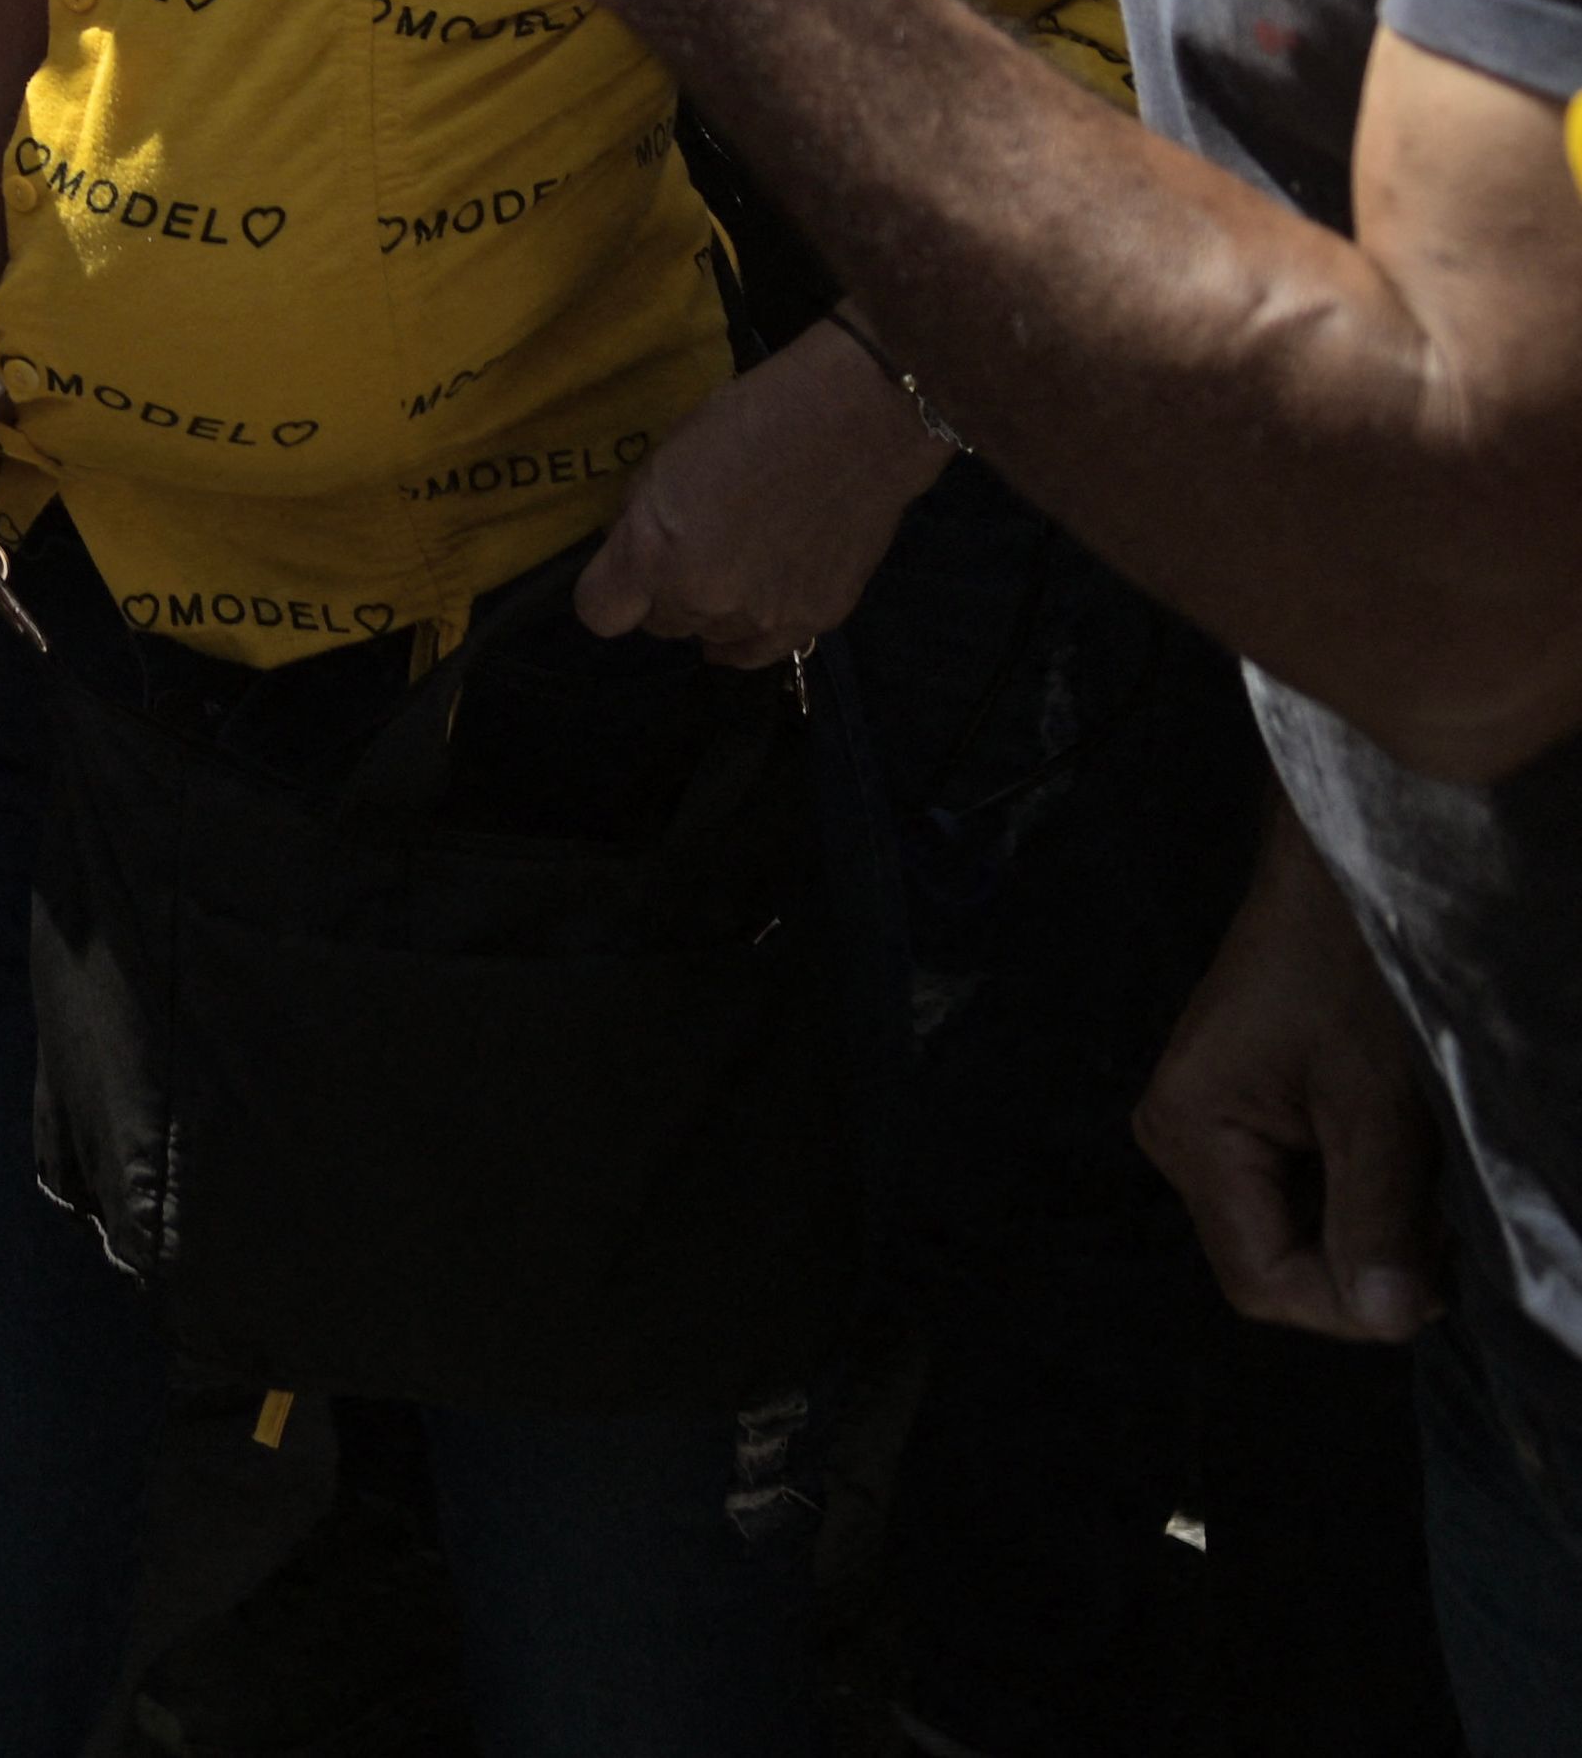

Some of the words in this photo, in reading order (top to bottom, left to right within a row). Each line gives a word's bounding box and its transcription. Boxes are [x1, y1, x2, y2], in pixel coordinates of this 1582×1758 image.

[46, 160, 228, 246] MODEL
[44, 366, 257, 446] MODEL
[426, 447, 612, 501] MODEL
[168, 592, 351, 635] MODEL
